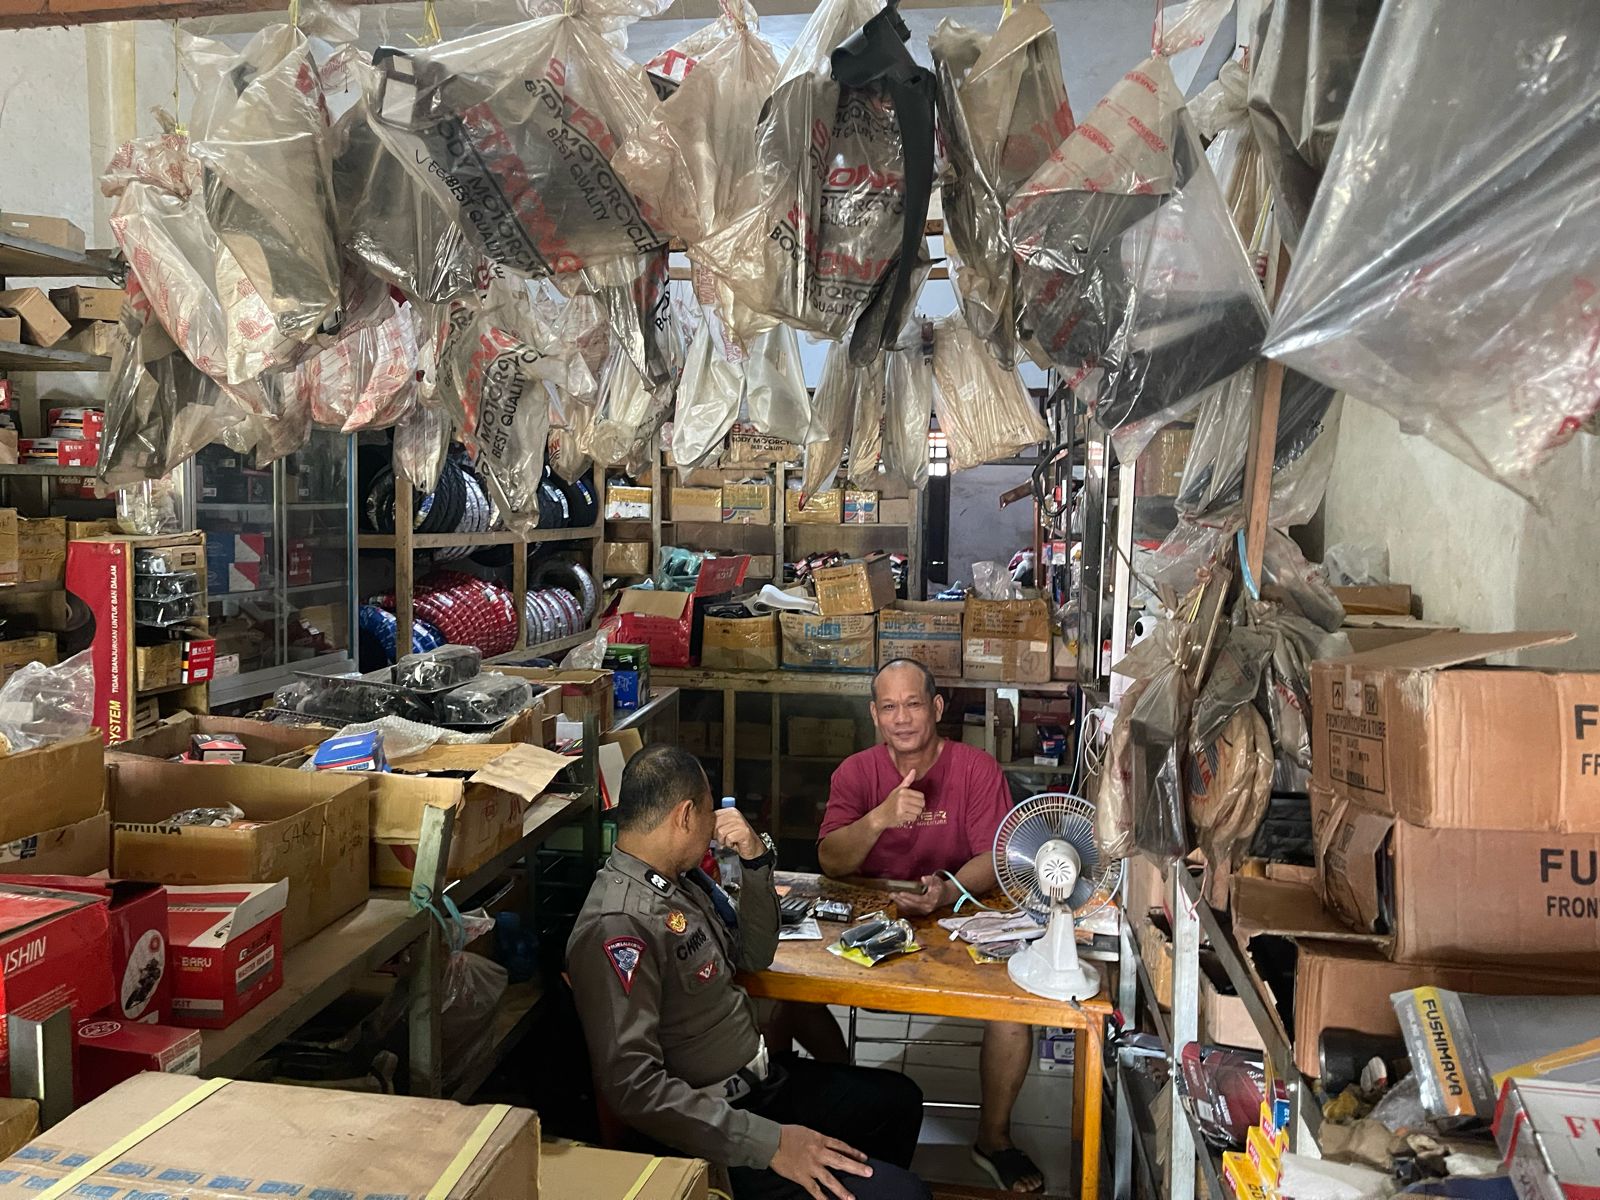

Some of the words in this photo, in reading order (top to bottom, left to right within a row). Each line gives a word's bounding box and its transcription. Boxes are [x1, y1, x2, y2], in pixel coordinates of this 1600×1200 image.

[437, 118, 477, 169] ODY
[546, 126, 576, 162] BEST
[569, 162, 610, 222] QUALITY
[560, 128, 652, 256] MOTORCYCLE
[492, 430, 509, 461] BEST
[501, 371, 527, 428] QUALITY
[181, 956, 212, 968] BARU
